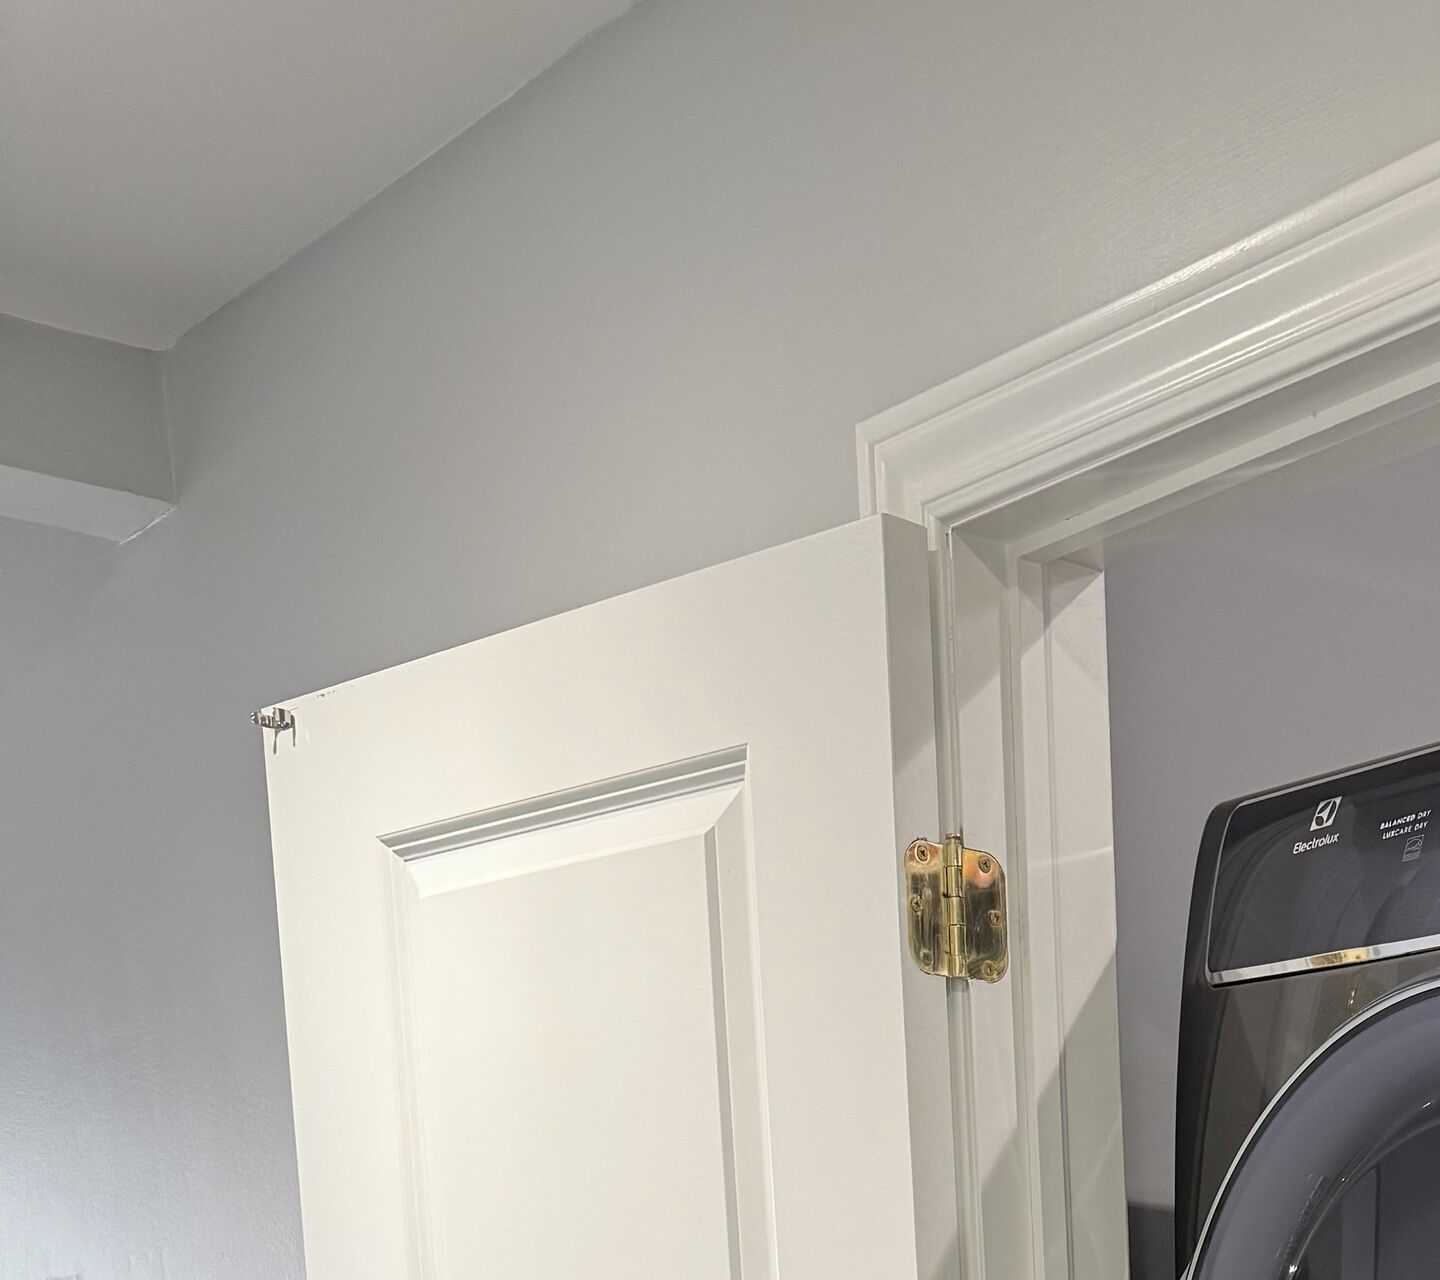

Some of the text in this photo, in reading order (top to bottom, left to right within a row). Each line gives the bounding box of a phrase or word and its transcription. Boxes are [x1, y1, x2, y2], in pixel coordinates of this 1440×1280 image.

[1380, 809, 1432, 830] BALANCED DRY
[1382, 821, 1429, 839] LUXCARE DRY
[1293, 833, 1339, 854] Electrolux
